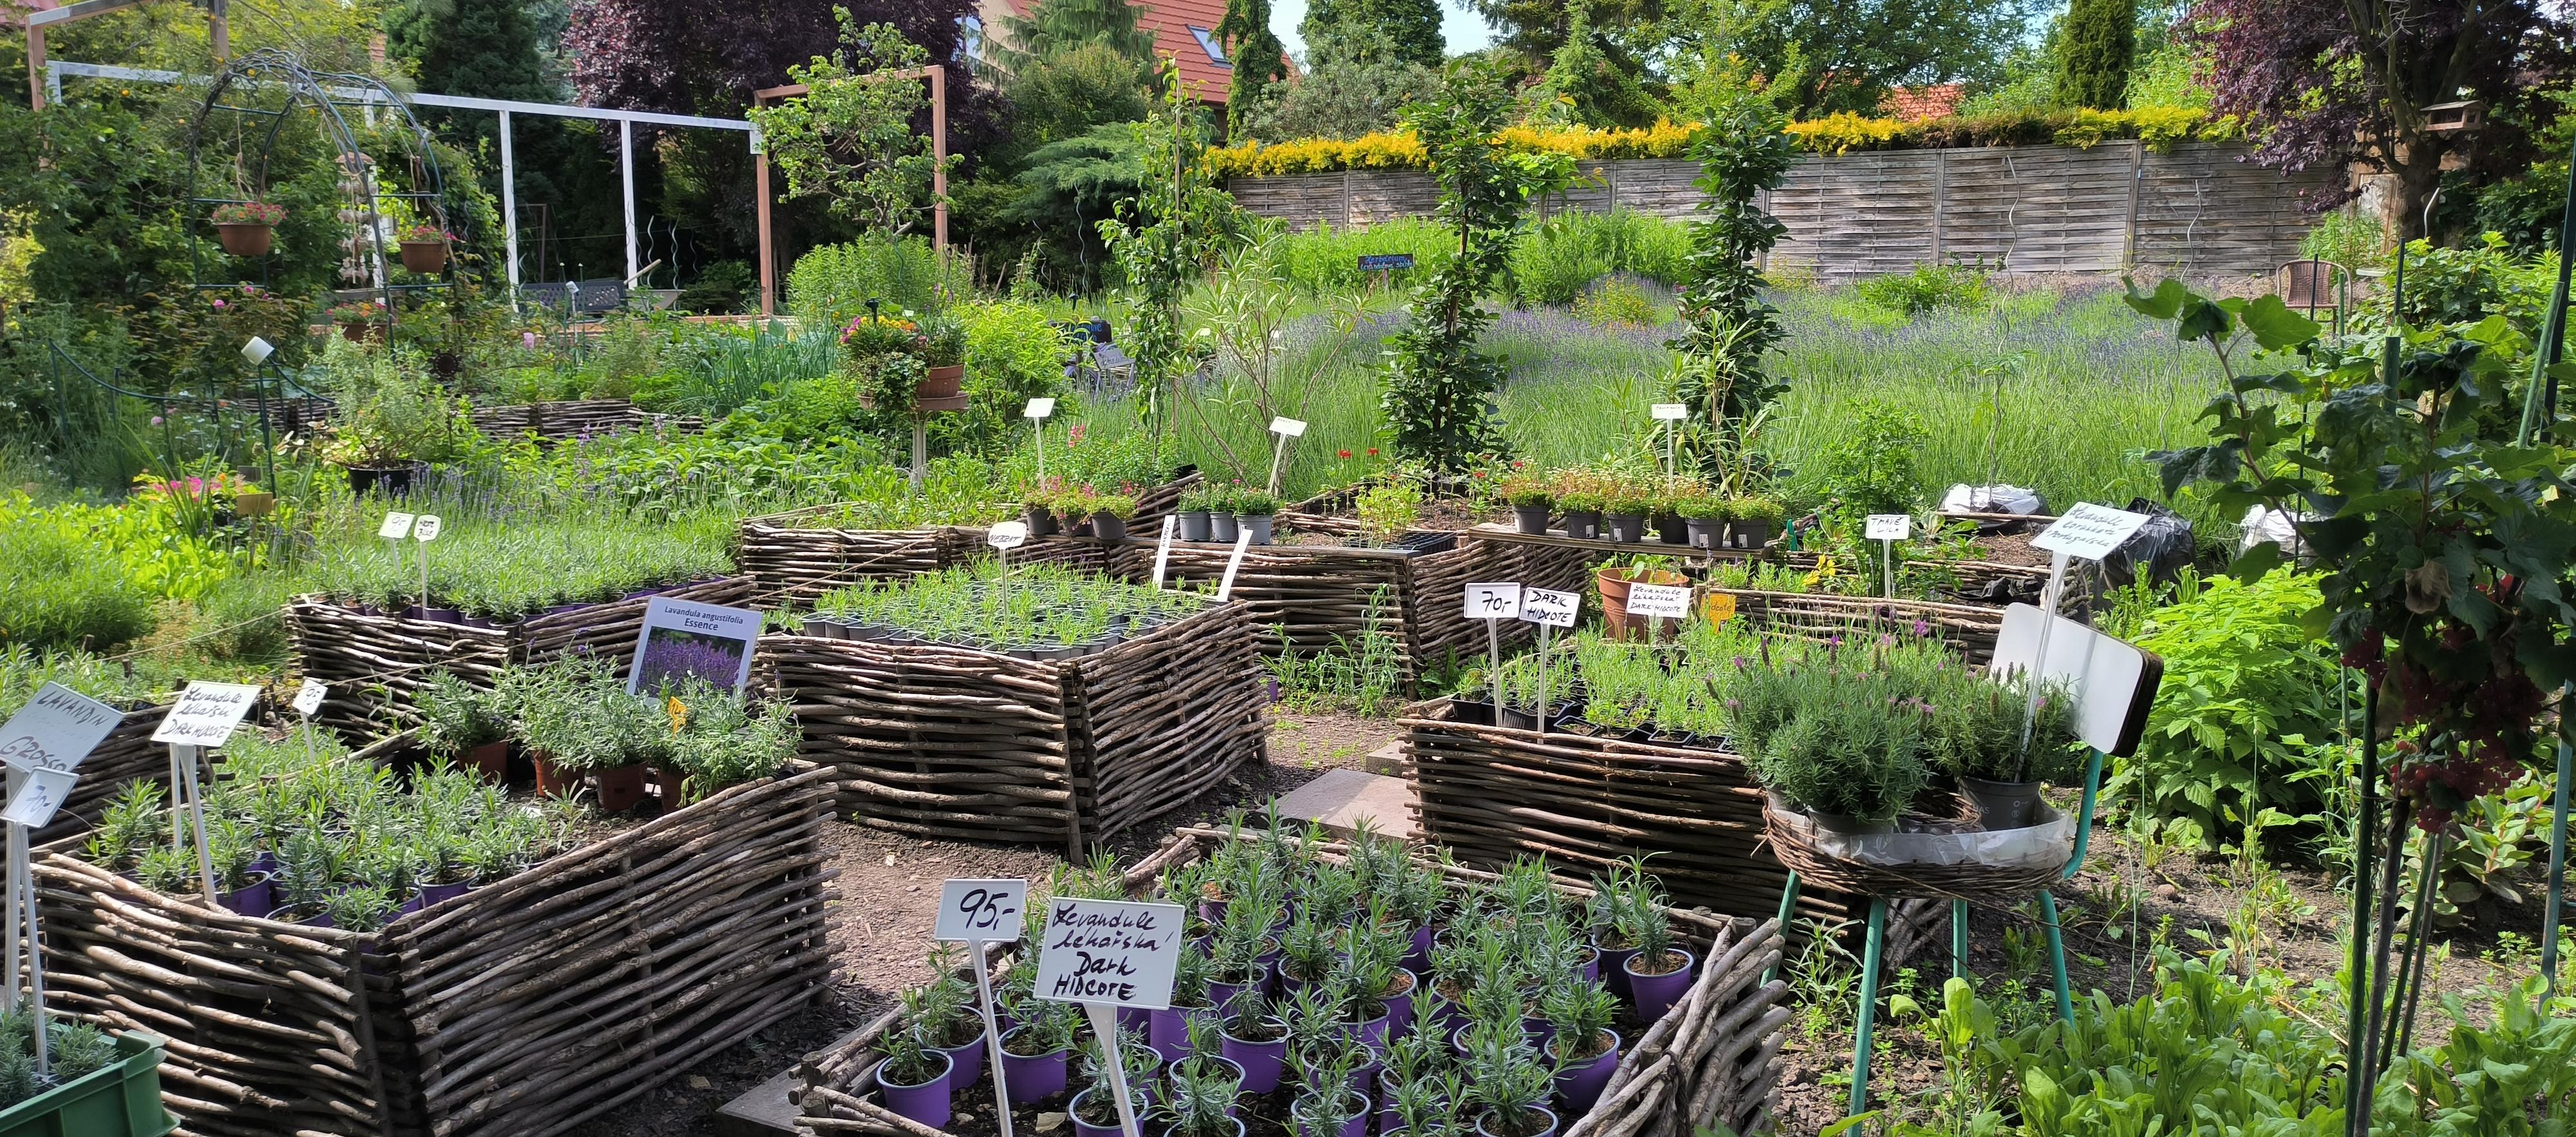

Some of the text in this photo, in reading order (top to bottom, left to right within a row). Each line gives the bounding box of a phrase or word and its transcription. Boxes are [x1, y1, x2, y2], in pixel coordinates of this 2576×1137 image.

[1482, 591, 1511, 613] 70,-
[1530, 590, 1567, 607] DARK
[1629, 602, 1651, 610] DARK
[665, 606, 743, 624] Lavandula angustifolia
[685, 618, 719, 631] Essence
[1527, 606, 1571, 622] HIDCOTE
[37, 690, 109, 726] LAVANDIN
[960, 888, 1016, 931] 95,-
[1052, 903, 1158, 930] Levandule
[1073, 951, 1137, 977] Dark
[1052, 974, 1137, 1000] HIDCOTE
